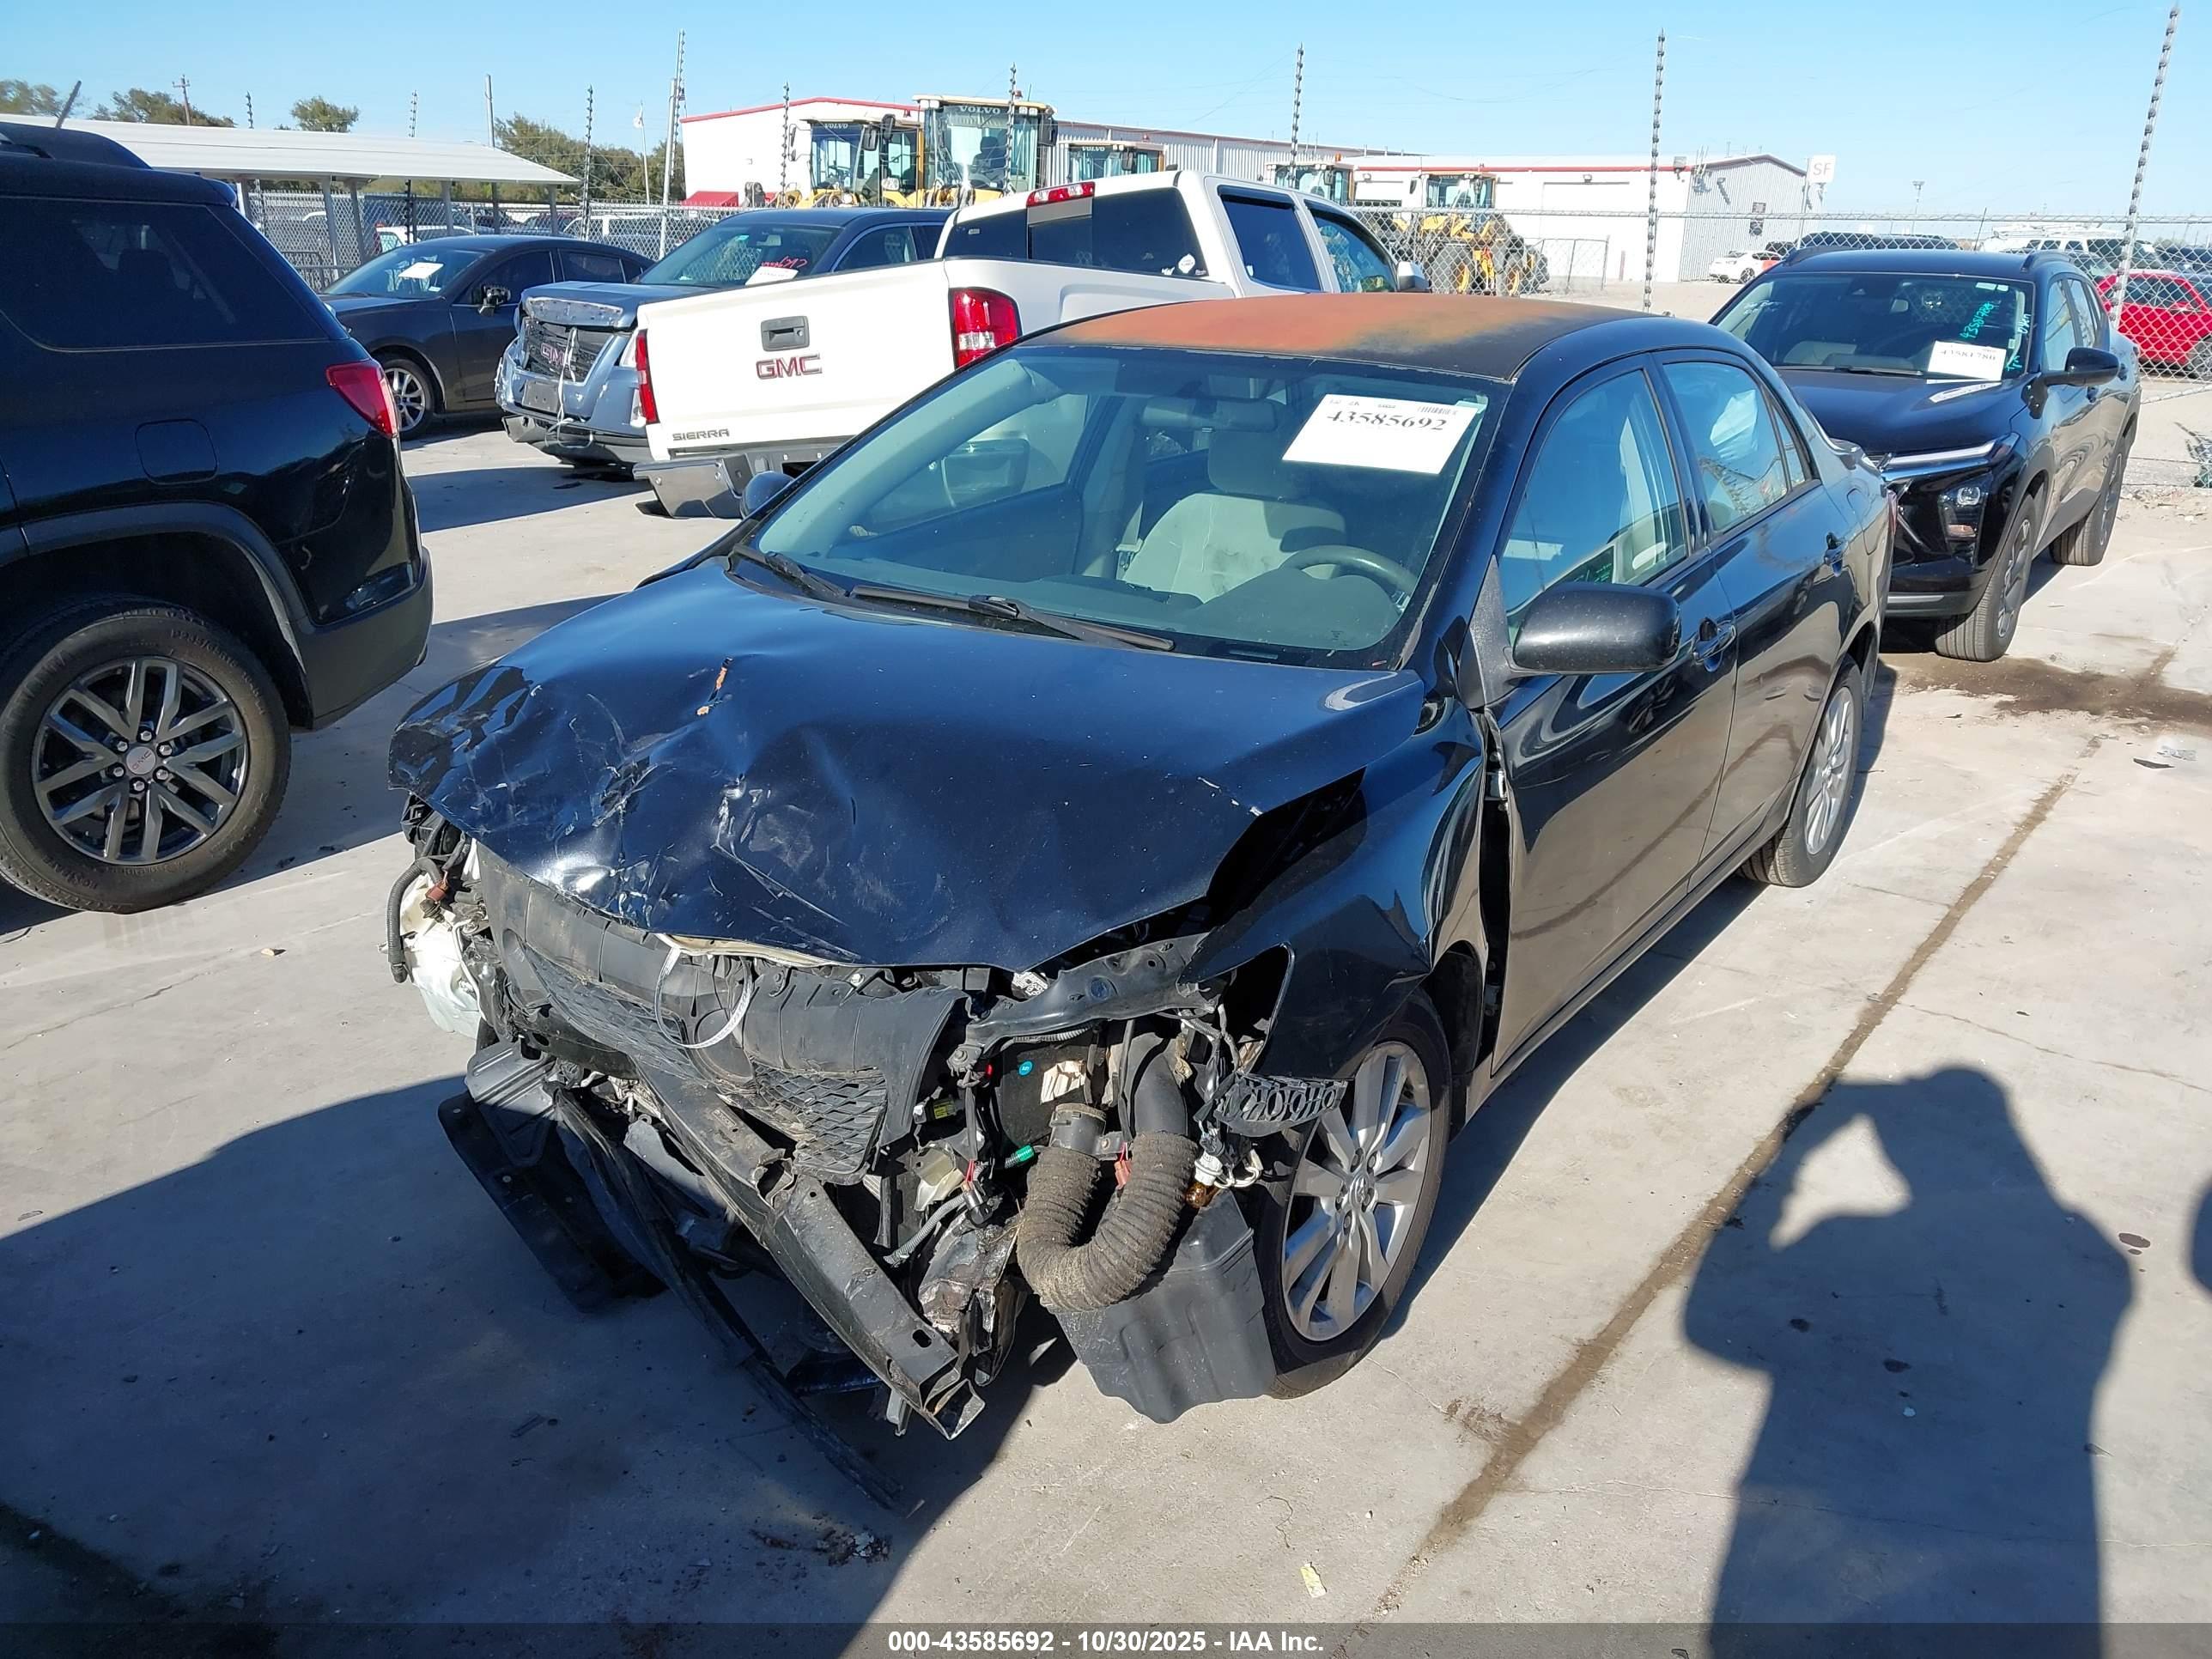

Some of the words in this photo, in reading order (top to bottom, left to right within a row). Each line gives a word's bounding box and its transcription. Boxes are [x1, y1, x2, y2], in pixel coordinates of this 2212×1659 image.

[959, 105, 1001, 115] VOLVO
[1813, 161, 1832, 176] SF
[756, 353, 823, 380] GMC
[1327, 410, 1448, 431] 43585692
[672, 428, 730, 441] SIERRA
